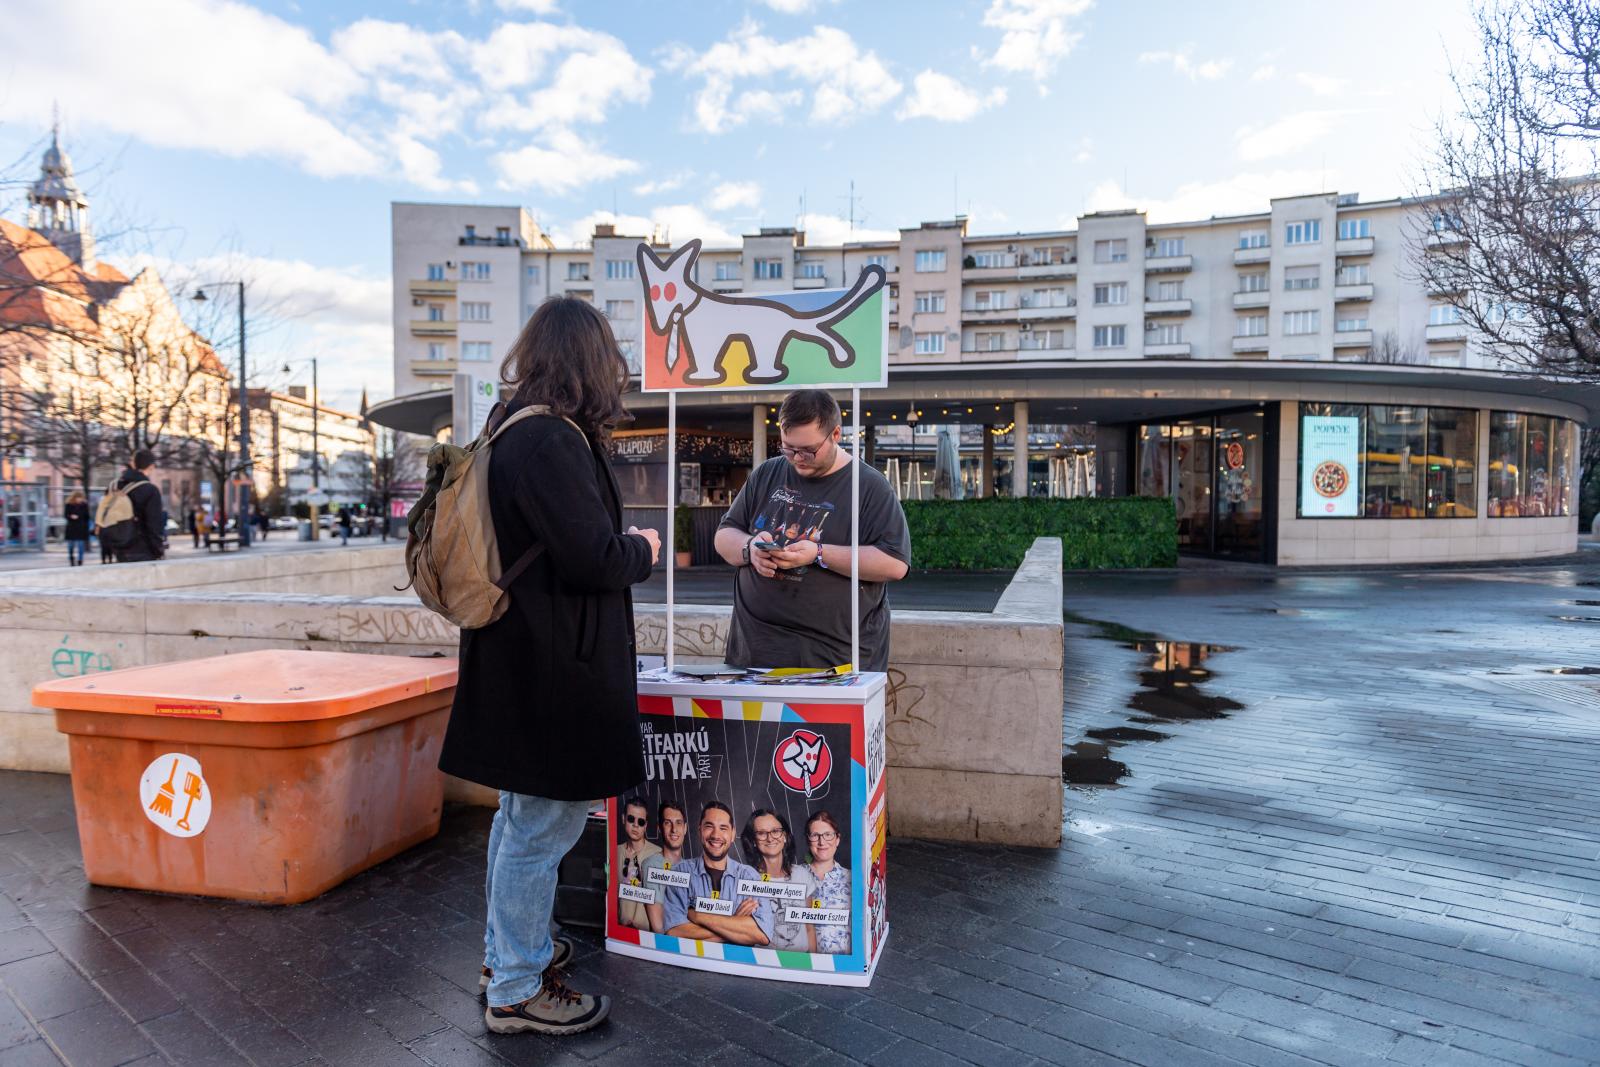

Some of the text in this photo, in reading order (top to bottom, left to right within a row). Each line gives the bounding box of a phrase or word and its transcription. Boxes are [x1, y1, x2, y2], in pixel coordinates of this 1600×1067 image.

[642, 726, 709, 754] TFARKÚ
[650, 871, 670, 882] Sándor
[741, 883, 802, 897] Dr. Neulinger Ágnes
[699, 900, 730, 911] Nagy Dávid
[790, 910, 847, 922] Dr. Pásztor Eszter
